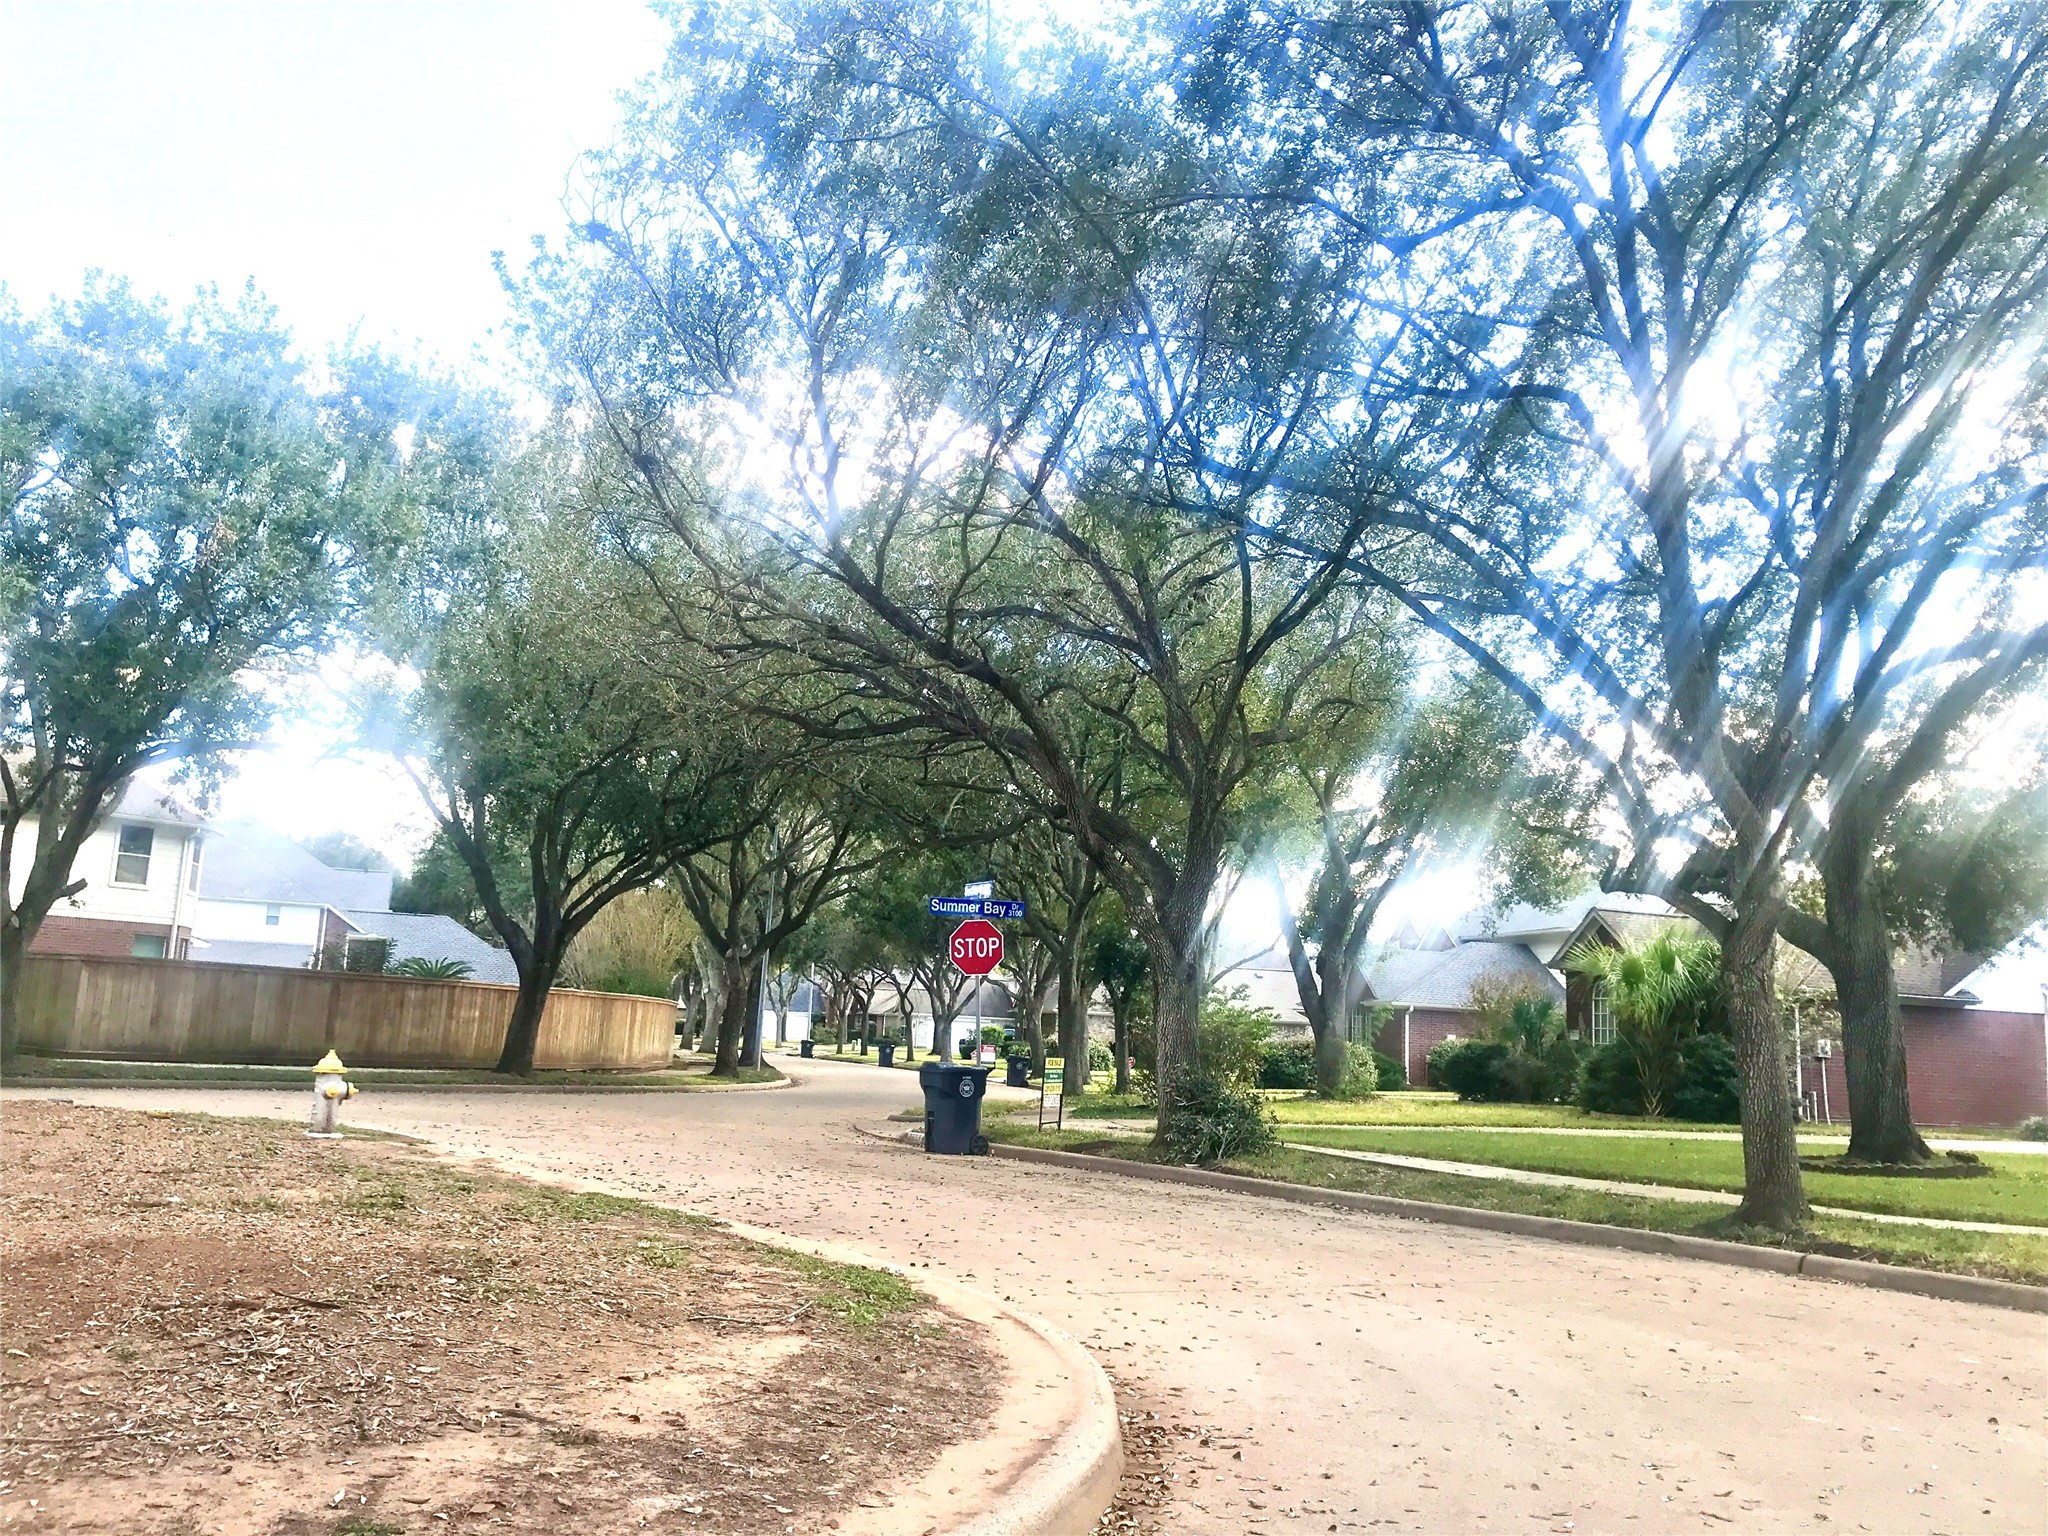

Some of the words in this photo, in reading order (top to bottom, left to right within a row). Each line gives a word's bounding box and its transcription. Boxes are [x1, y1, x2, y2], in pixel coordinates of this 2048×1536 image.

[931, 899, 981, 913] Summer
[984, 901, 1006, 917] Bay
[953, 937, 999, 958] STOP
